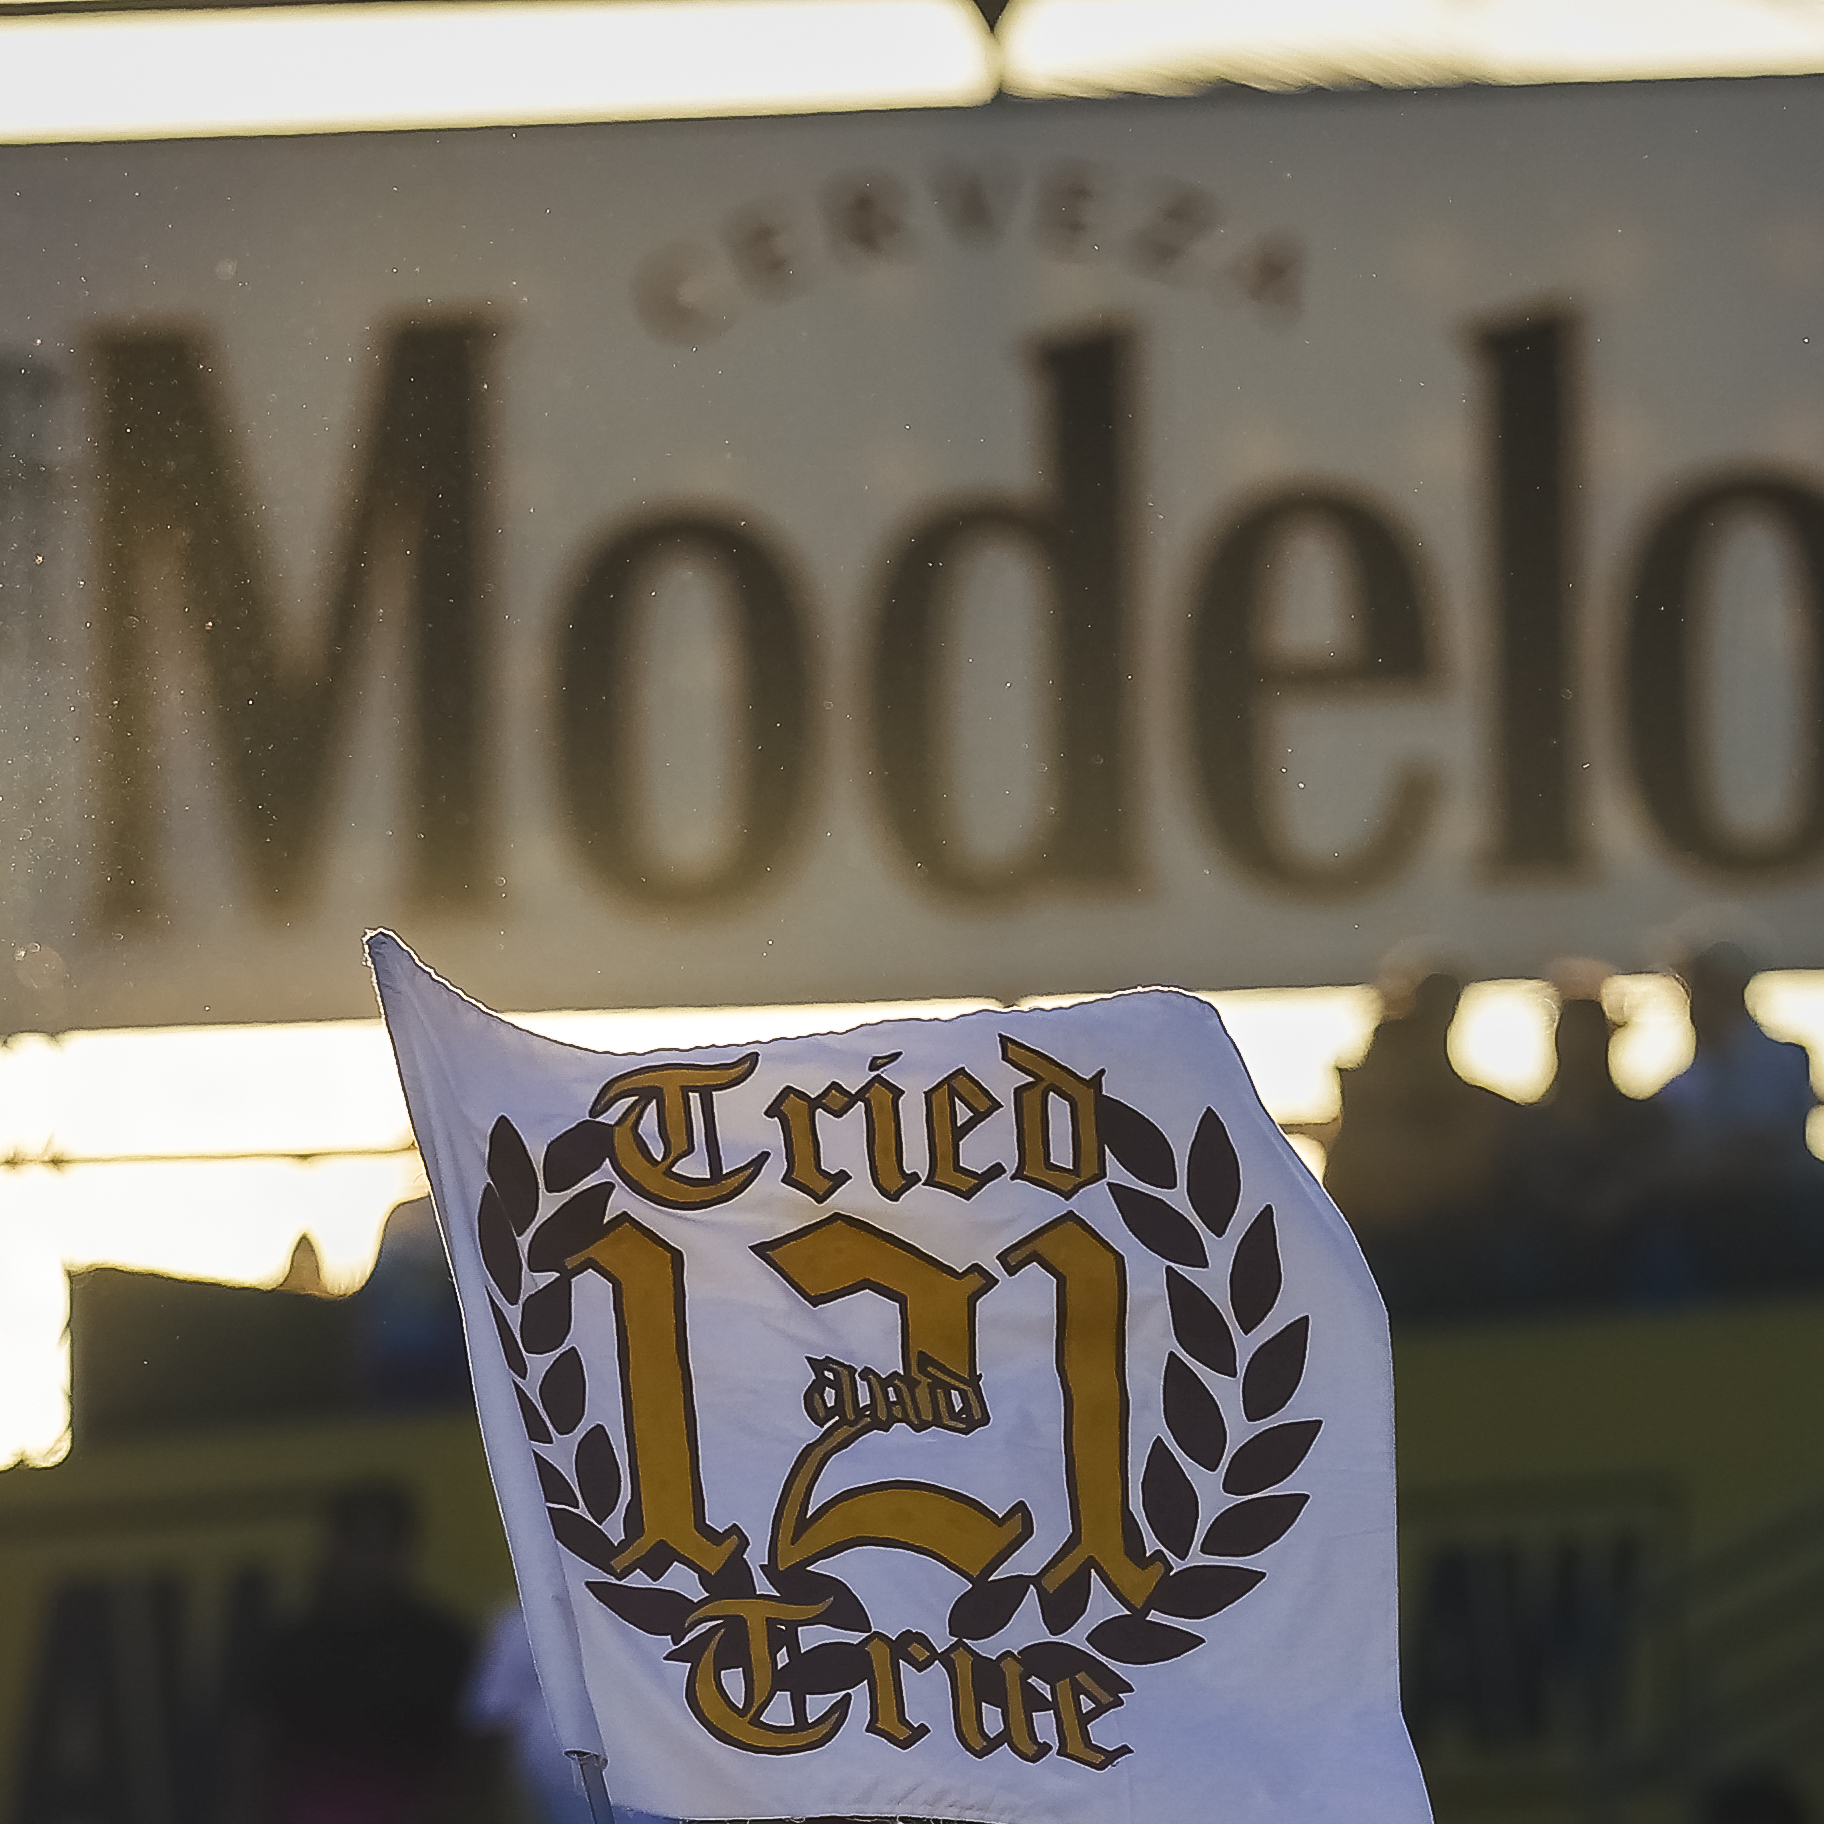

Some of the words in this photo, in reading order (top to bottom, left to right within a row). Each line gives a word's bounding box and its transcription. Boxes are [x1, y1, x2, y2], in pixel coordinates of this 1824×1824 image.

[636, 152, 1308, 345] CERVEZA
[588, 1034, 1106, 1209] Tried
[803, 1352, 991, 1431] and
[683, 1596, 1134, 1770] True
